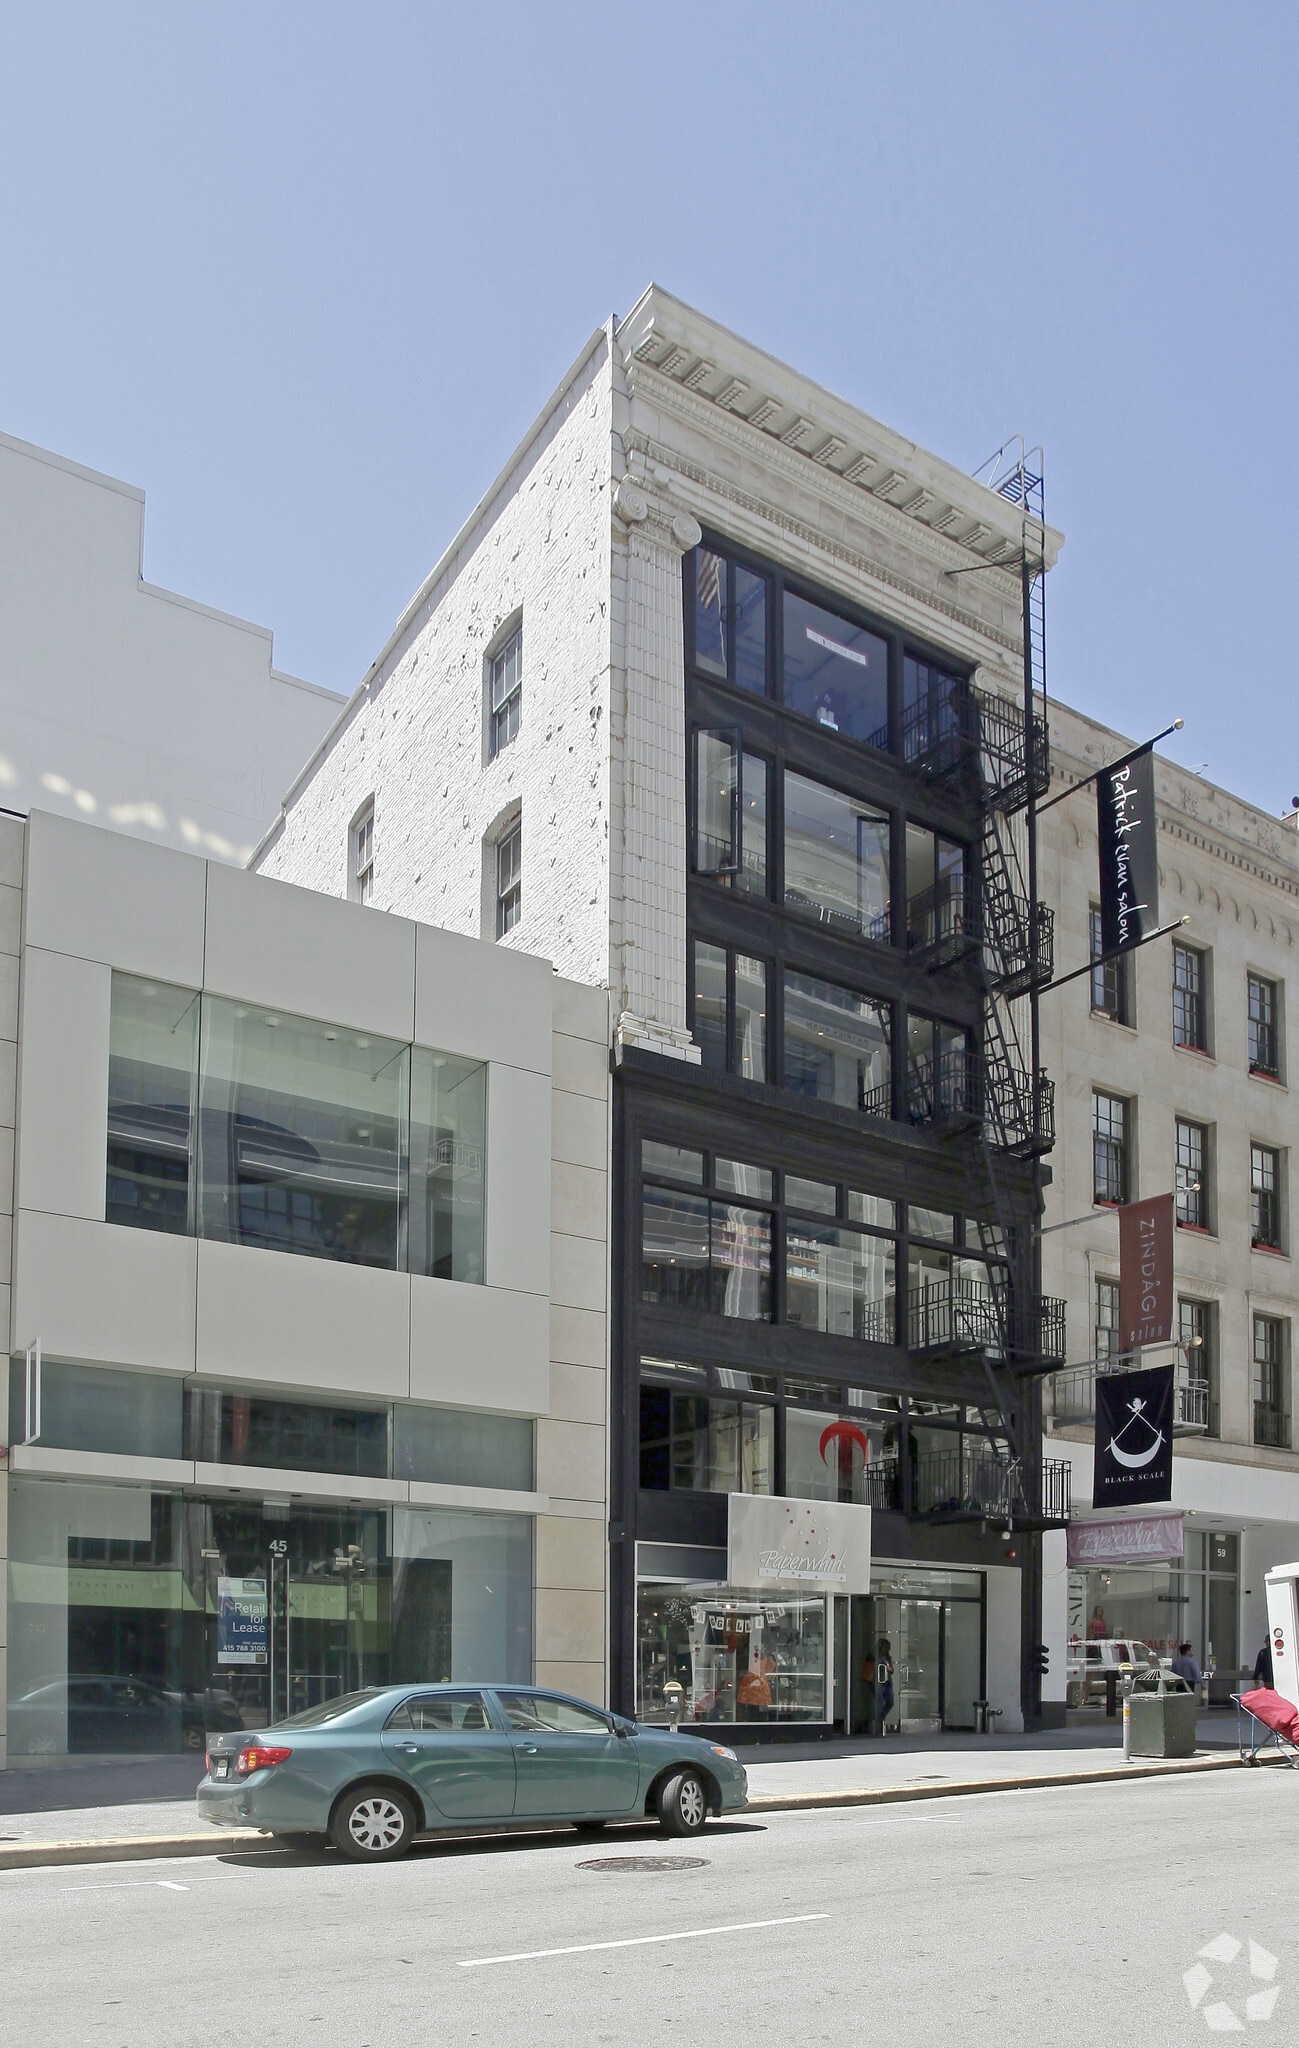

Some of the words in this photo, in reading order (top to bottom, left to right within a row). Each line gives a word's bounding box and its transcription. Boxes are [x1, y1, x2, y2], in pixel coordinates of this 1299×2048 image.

[1110, 765, 1142, 839] Patrick
[1115, 844, 1130, 888] evan
[1117, 892, 1148, 944] salon
[1130, 1325, 1163, 1342] salon
[1104, 1475, 1135, 1484] BLACK
[1138, 1470, 1165, 1480] SCALE
[269, 1539, 288, 1552] 45
[1217, 1548, 1226, 1558] 59
[758, 1547, 847, 1581] Paperwhirl
[233, 1602, 266, 1613] Retail
[250, 1613, 265, 1624] for
[232, 1621, 266, 1633] Lease
